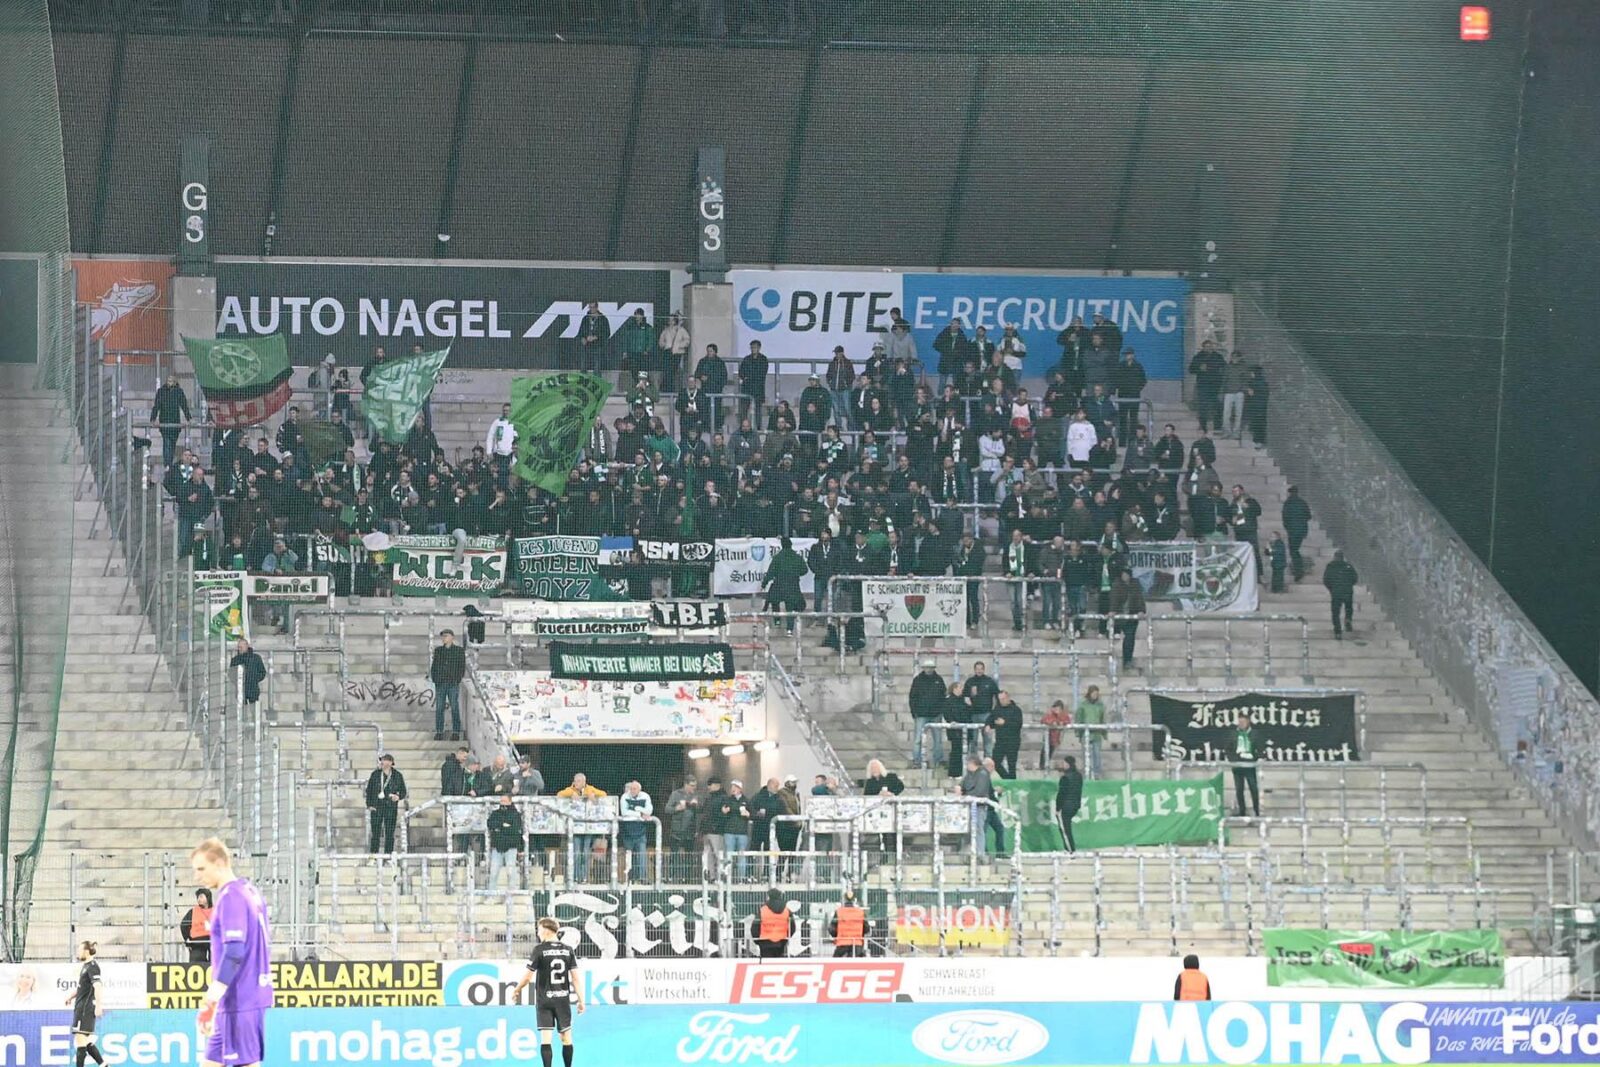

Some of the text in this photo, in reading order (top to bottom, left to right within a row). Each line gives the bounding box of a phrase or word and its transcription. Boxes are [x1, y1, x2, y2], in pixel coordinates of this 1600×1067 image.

[217, 296, 511, 338] AUTO NAGEL
[789, 290, 893, 333] BITE
[916, 295, 1179, 334] E-RECRUITING
[549, 539, 599, 554] JUGEND
[1130, 551, 1194, 568] ORTFREUNDE
[254, 578, 318, 594] Daniel
[867, 584, 875, 594] FC
[879, 583, 921, 594] SCHWEINFURT
[936, 583, 964, 594] FANCLUB
[538, 621, 648, 635] KUGELLAGERSTADT
[882, 622, 951, 634] ELDERSHEIM
[561, 654, 702, 673] INHAFTIERTE IMMER BEI UNS
[1188, 700, 1321, 729] Fanatics
[1163, 738, 1352, 763] Schinfurt
[904, 898, 1006, 933] RHÖN
[151, 962, 438, 991] TROERALARM.DE
[550, 958, 566, 985] 2
[290, 1018, 538, 1067] mohag.de
[676, 1010, 801, 1063] Ford
[939, 1019, 1020, 1053] Ford
[1129, 1001, 1431, 1064] MOHAG
[1436, 1035, 1467, 1052] Das
